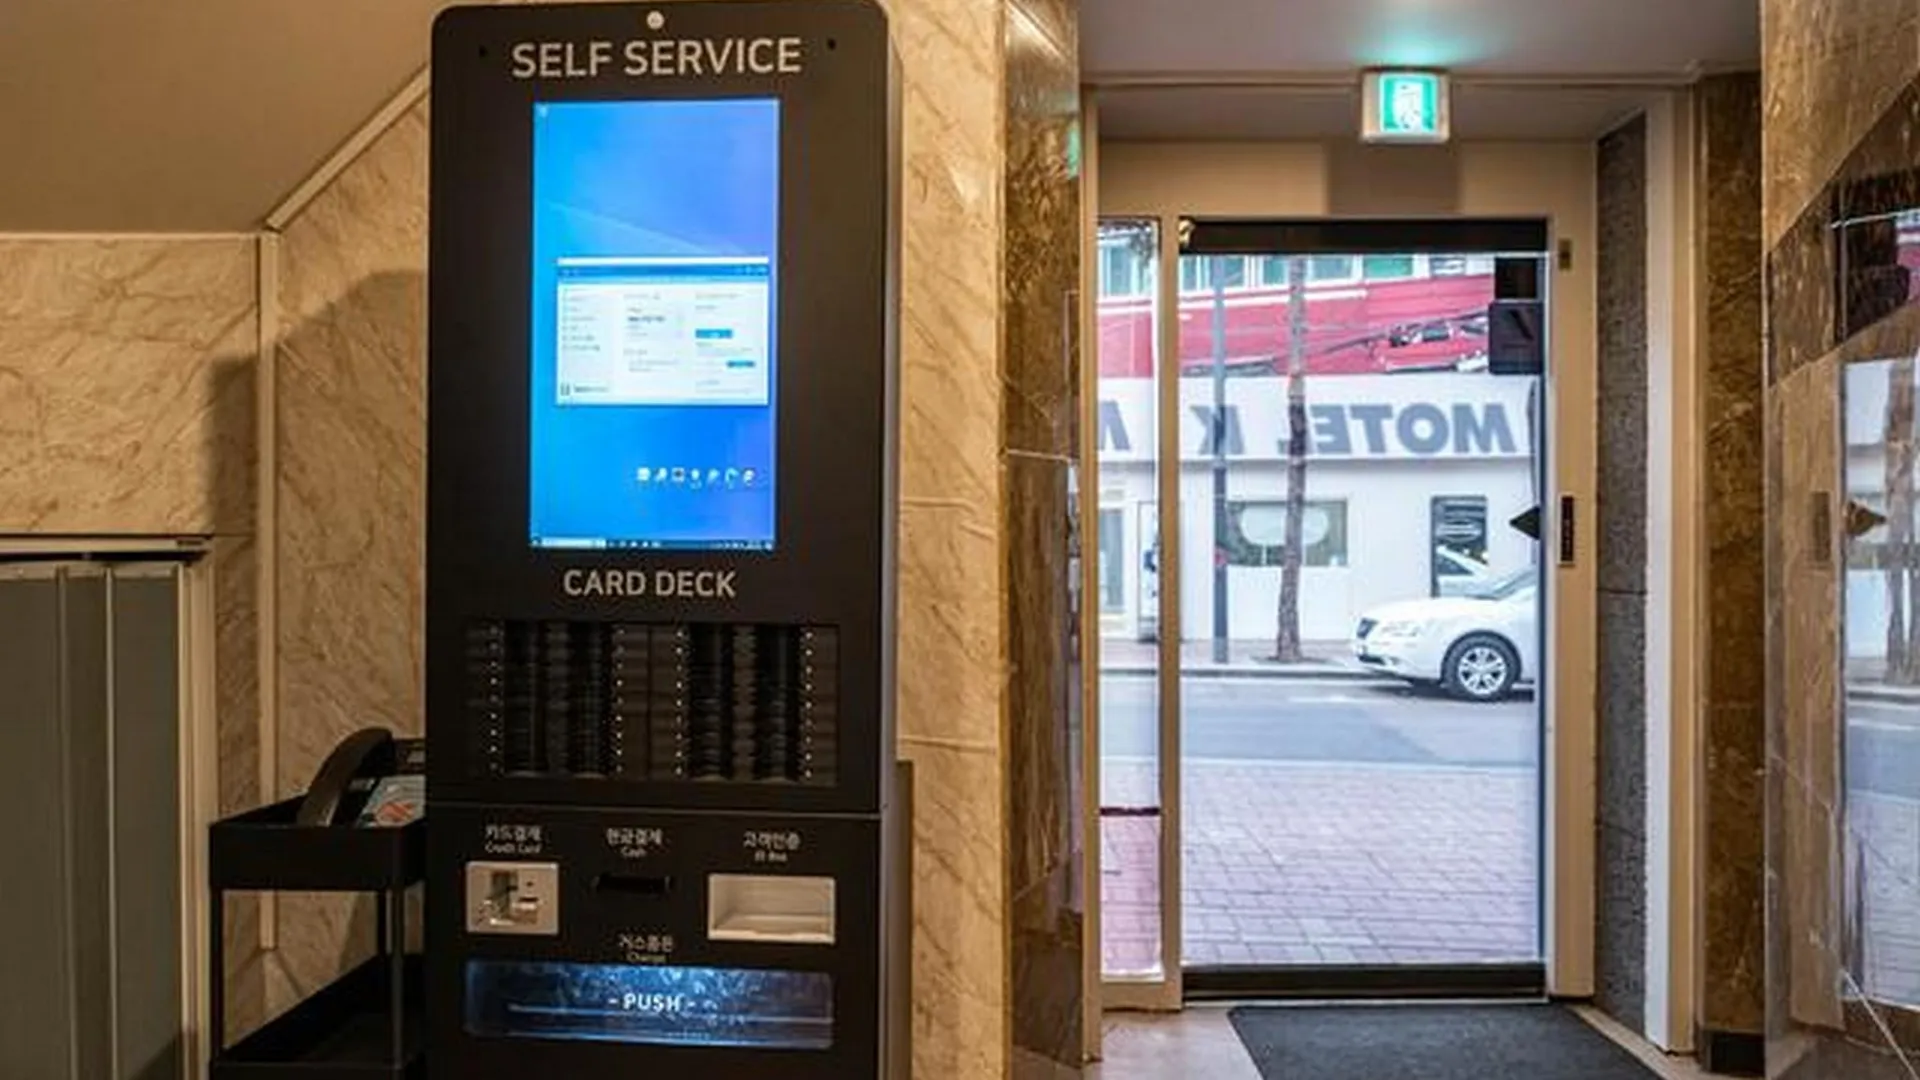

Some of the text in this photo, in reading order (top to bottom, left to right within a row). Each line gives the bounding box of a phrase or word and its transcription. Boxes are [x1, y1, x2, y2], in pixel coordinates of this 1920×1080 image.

[512, 38, 802, 77] SELF SERVICE
[563, 570, 737, 598] CARD DECK
